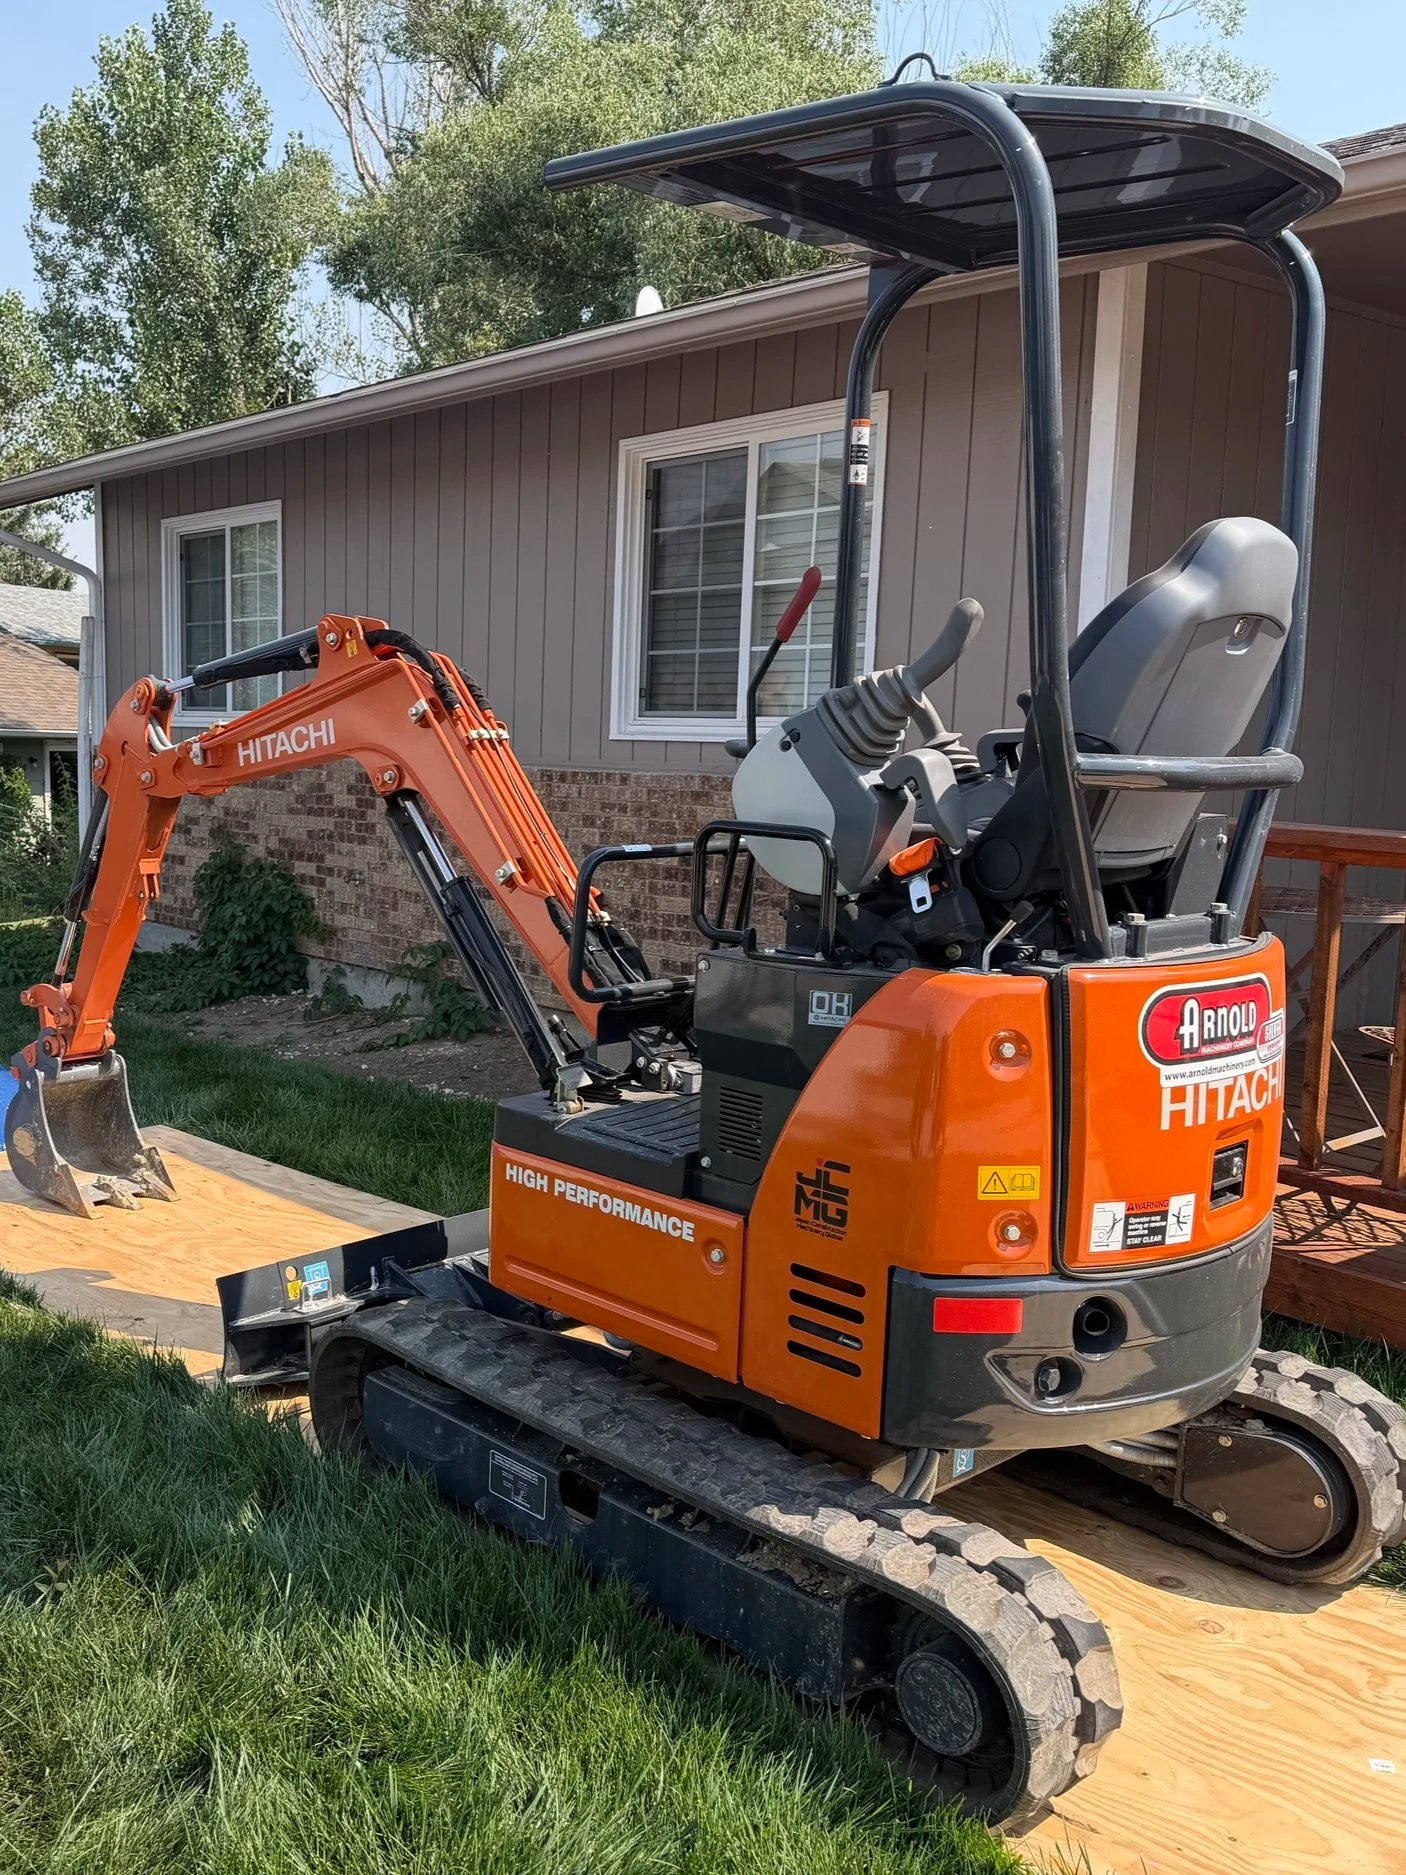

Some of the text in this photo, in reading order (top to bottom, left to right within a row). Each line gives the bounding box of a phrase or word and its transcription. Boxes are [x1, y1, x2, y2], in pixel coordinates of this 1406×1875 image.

[238, 719, 335, 766] HITACHI
[1179, 999, 1257, 1049] ARNOLD
[1201, 1043, 1233, 1054] MACHINERY
[1233, 1037, 1255, 1048] COMPANY
[1164, 1058, 1256, 1081] www.arnoldmachinery.com
[1160, 1061, 1283, 1131] HITACHI
[505, 1163, 695, 1243] HIGH PERFORMANCE
[1134, 1199, 1169, 1210] WARNING
[811, 1221, 848, 1236] Construction
[1129, 1216, 1150, 1224] Operator
[796, 1223, 824, 1236] Machinery
[1126, 1235, 1162, 1245] STAY CLEAR
